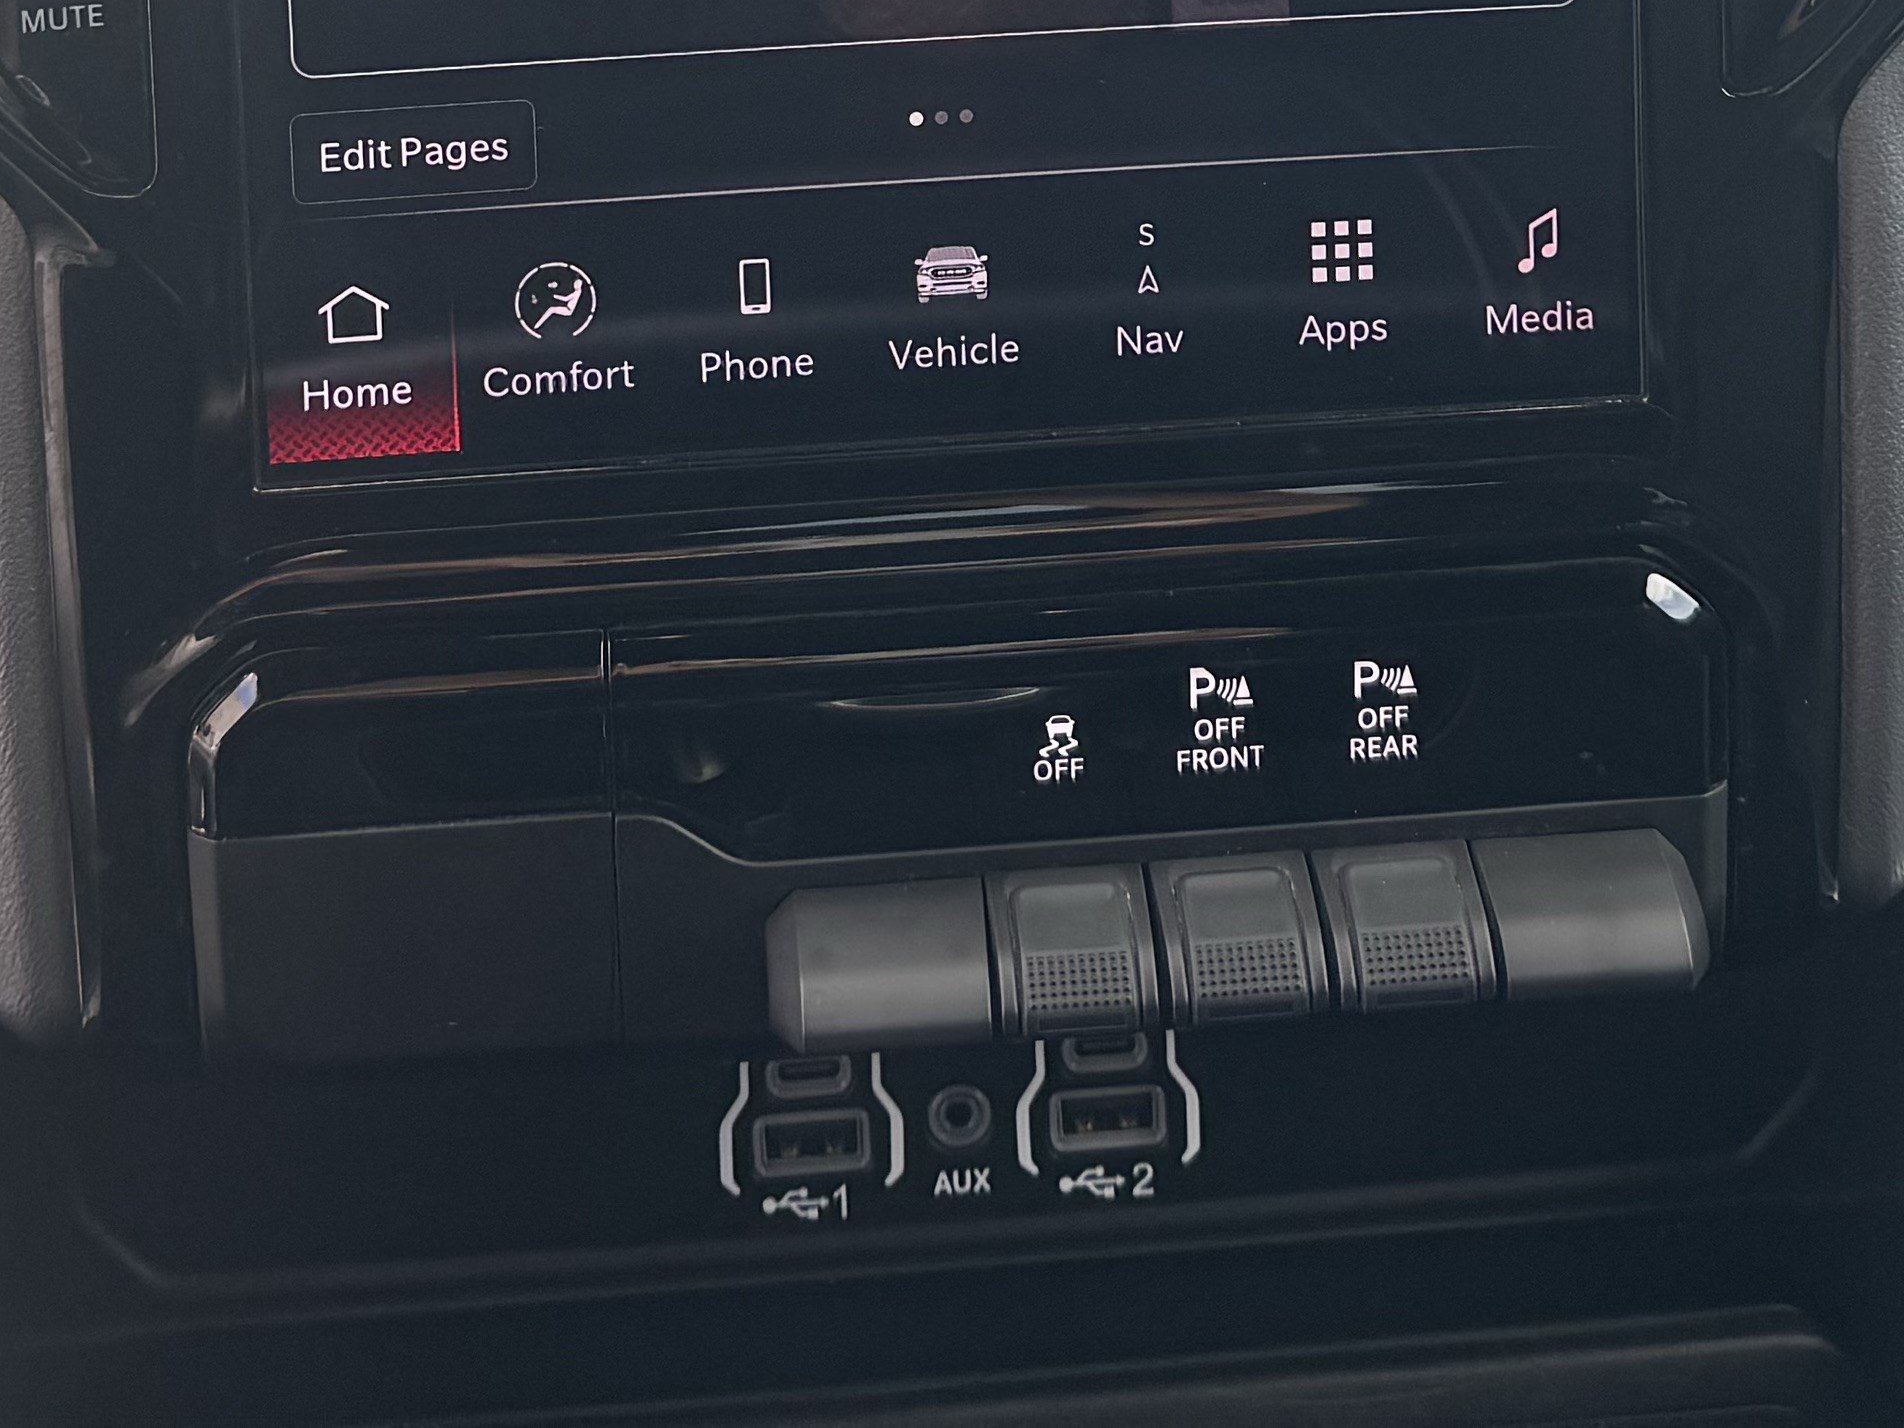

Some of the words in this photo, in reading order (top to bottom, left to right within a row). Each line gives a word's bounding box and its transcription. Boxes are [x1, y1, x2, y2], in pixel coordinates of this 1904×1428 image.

[21, 3, 104, 34] MUTE
[320, 141, 391, 173] Edit
[399, 135, 509, 170] Pages
[1139, 222, 1155, 246] S
[1299, 314, 1387, 350] Apps
[1486, 303, 1595, 335] Media
[888, 333, 1020, 370] Vehicle
[1115, 325, 1184, 356] Nav
[483, 359, 635, 398] Comfort
[700, 351, 815, 383] Phone
[302, 376, 413, 411] Home
[1194, 716, 1245, 741] OFF
[1358, 706, 1409, 730] OFF
[1177, 745, 1264, 772] FRONT
[1350, 734, 1418, 761] REAR
[1033, 758, 1084, 782] OFF
[934, 1167, 991, 1196] AUX
[1132, 1162, 1155, 1197] 2
[833, 1184, 848, 1221] 1
